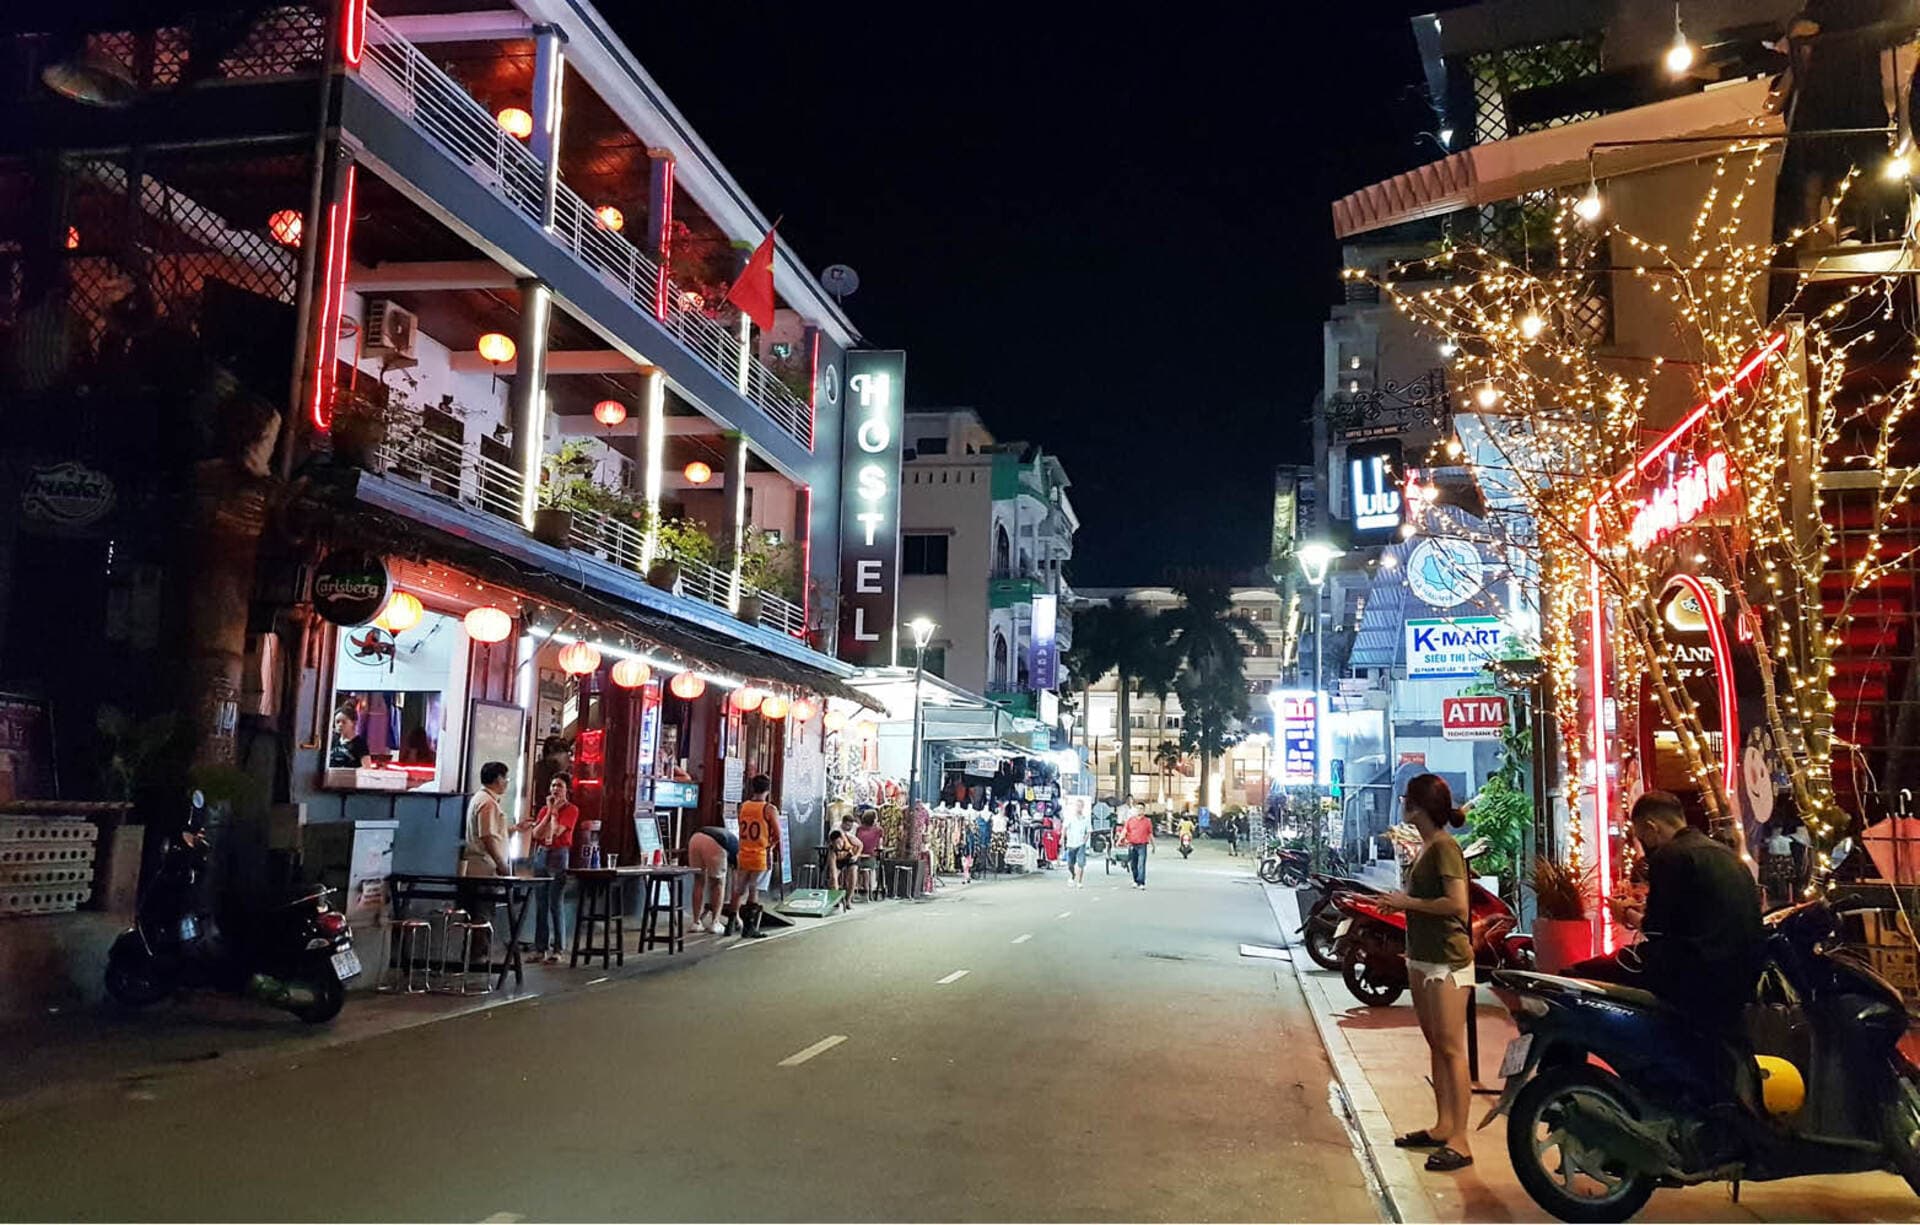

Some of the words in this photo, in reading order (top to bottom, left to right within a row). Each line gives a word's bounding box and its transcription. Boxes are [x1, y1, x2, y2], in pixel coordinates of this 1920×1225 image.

[849, 372, 891, 643] HOSTEL
[315, 574, 379, 599] Carlsberg
[1413, 627, 1500, 652] K-MART
[1448, 702, 1504, 723] ATM
[740, 820, 761, 841] 20
[1576, 998, 1635, 1016] VISION
